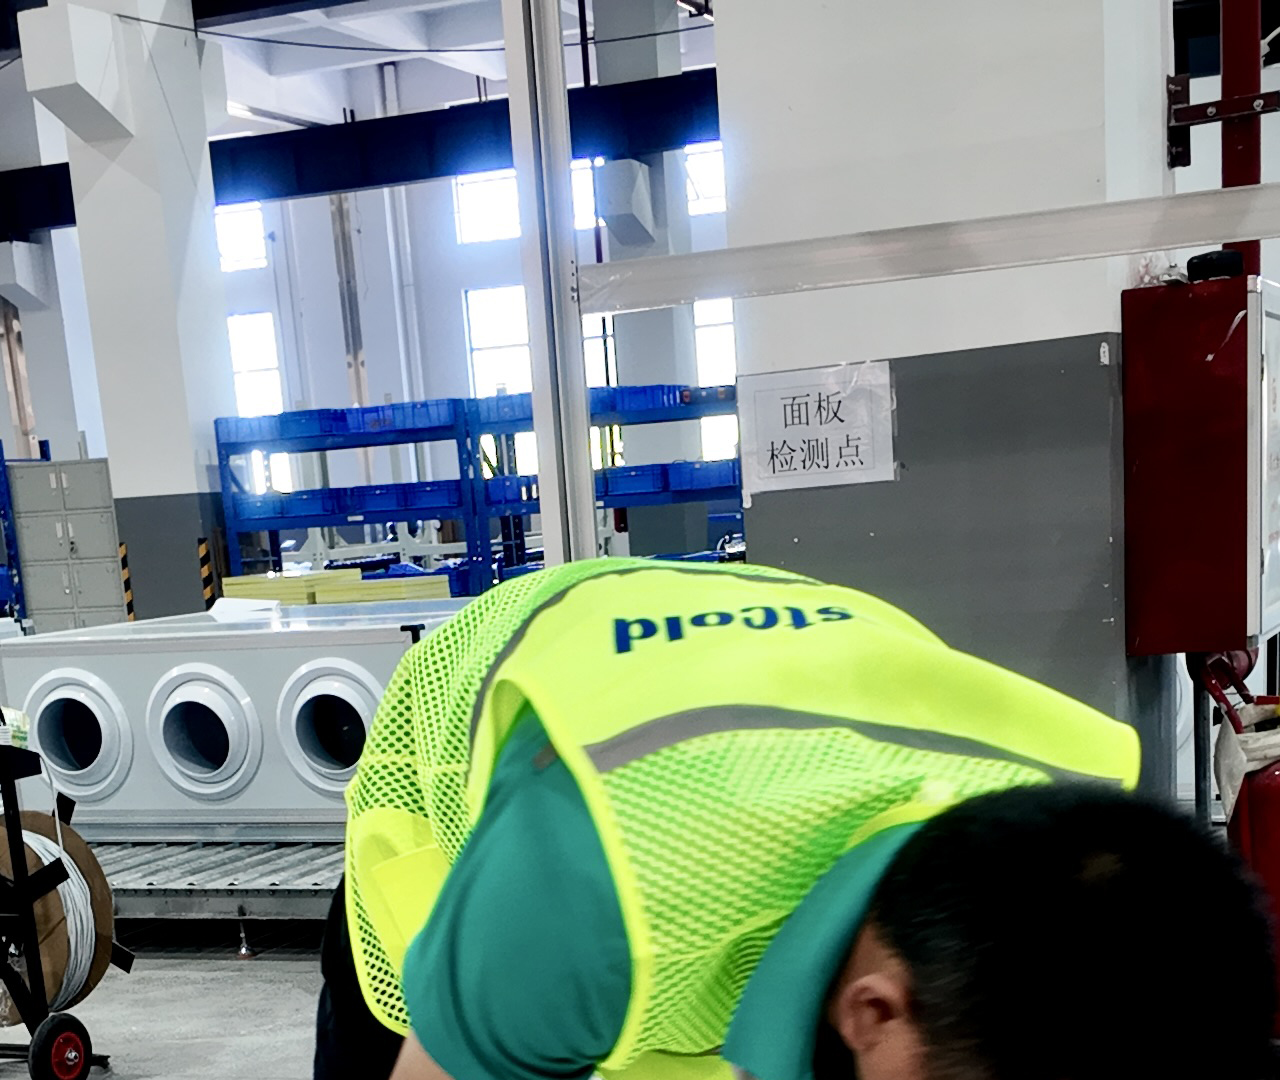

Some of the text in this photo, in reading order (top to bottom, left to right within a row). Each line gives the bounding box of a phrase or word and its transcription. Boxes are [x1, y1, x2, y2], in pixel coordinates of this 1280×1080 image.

[780, 390, 845, 429] 面板
[766, 433, 864, 475] 检测点
